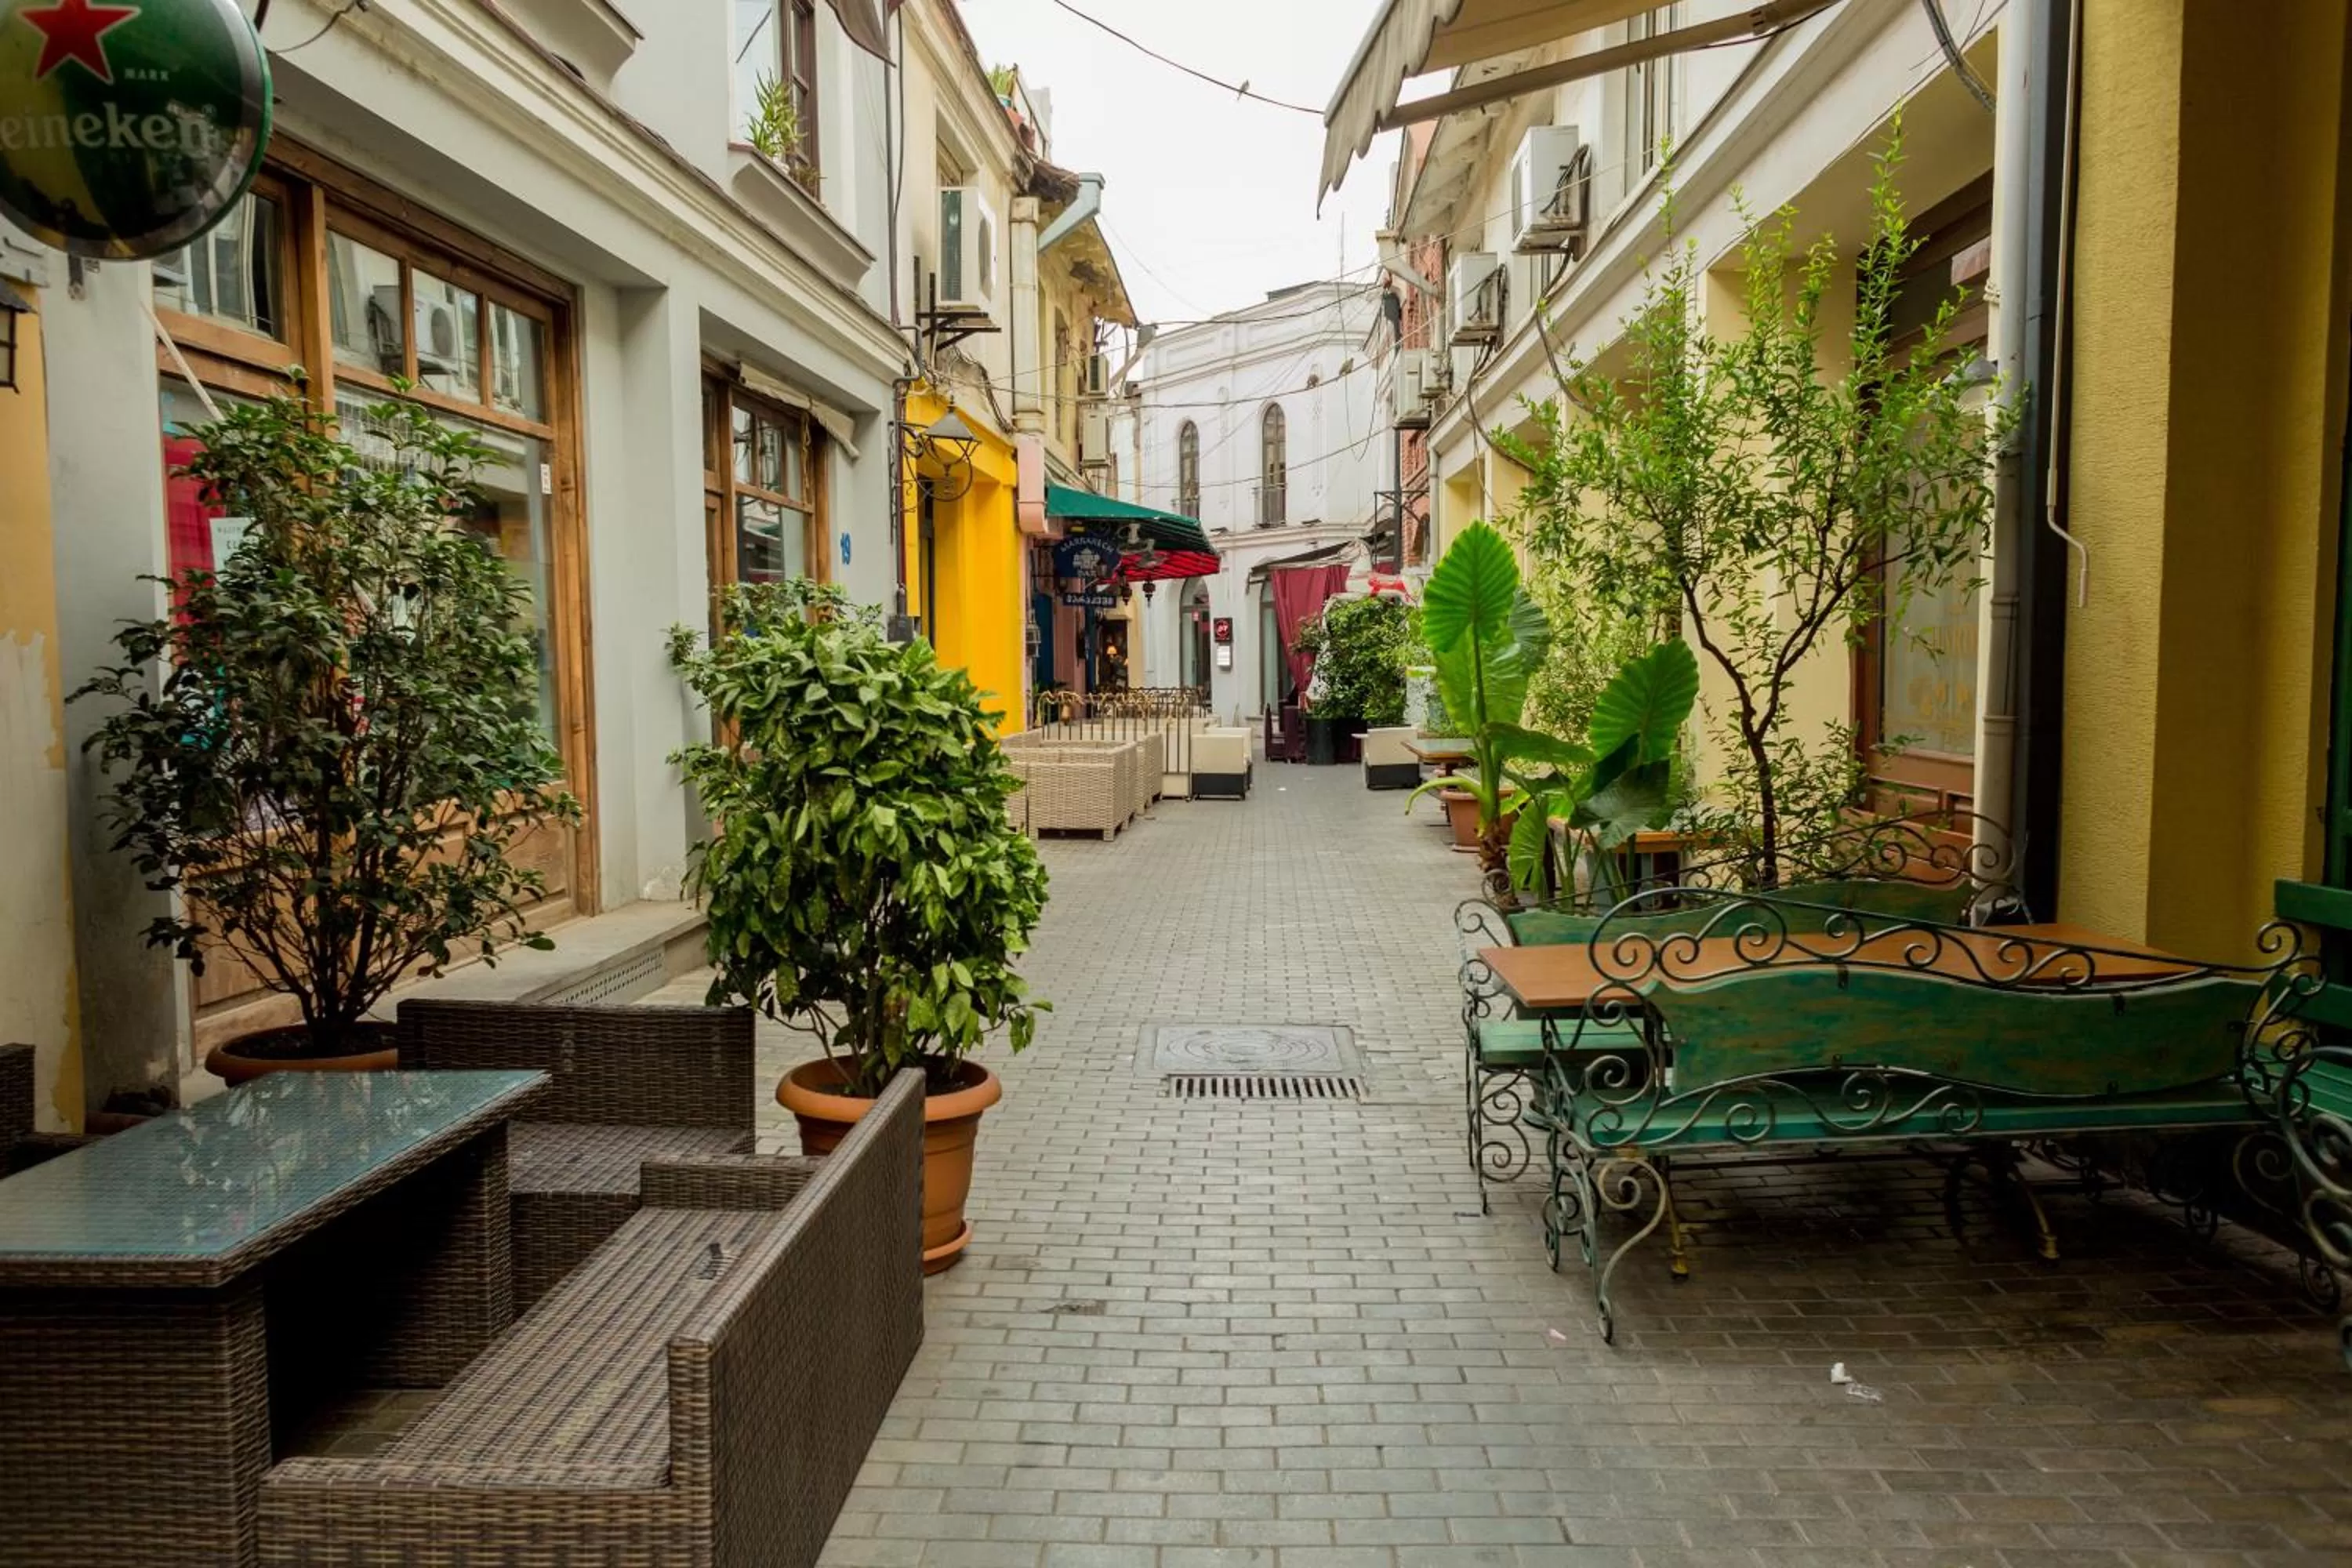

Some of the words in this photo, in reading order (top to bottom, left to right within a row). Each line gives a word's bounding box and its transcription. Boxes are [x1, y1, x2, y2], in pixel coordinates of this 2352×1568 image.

[124, 67, 170, 82] MARK
[0, 101, 211, 154] eineken
[840, 532, 851, 565] 19
